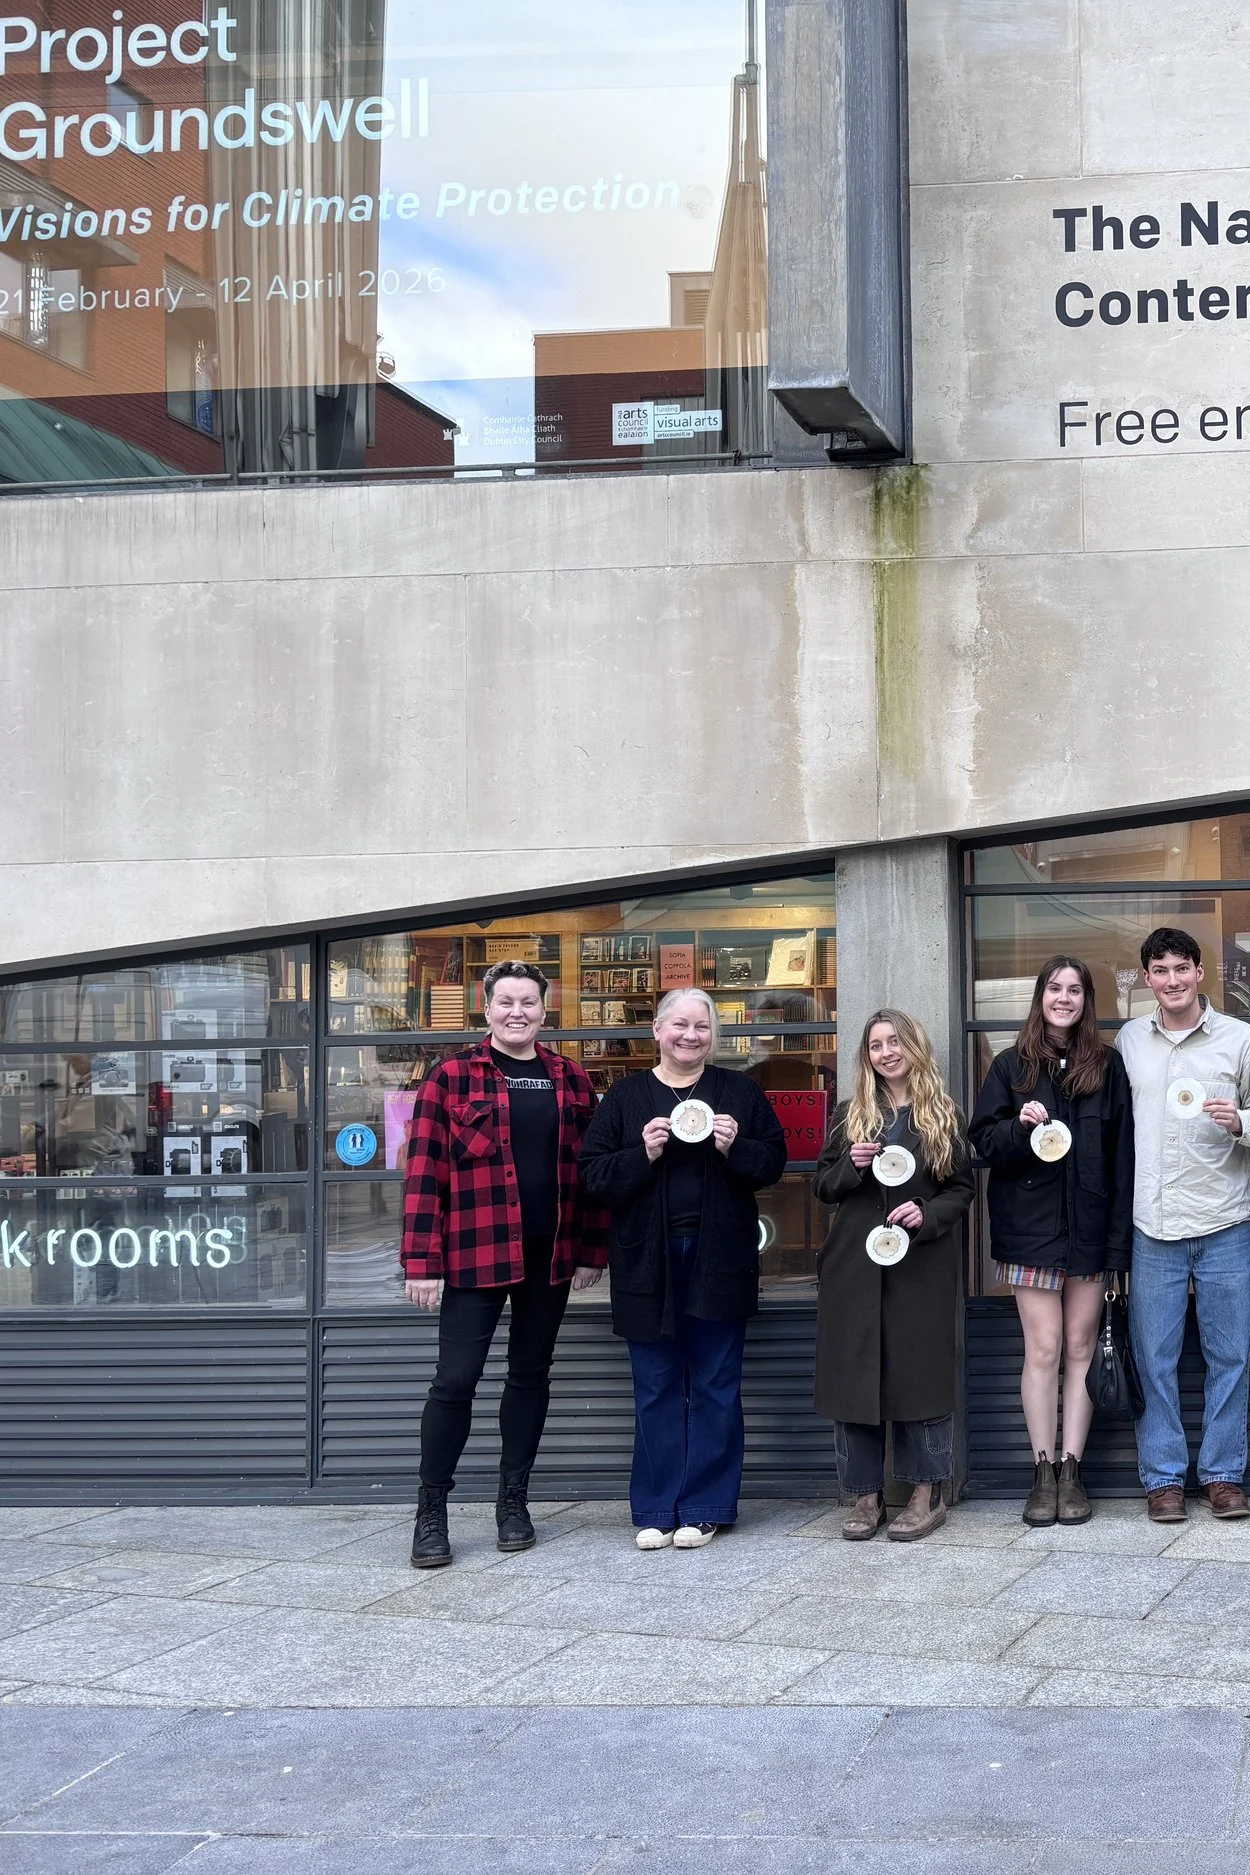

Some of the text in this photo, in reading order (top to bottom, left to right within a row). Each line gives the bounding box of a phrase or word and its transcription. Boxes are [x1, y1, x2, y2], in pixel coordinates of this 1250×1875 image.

[0, 7, 237, 85] Project
[0, 78, 430, 161] Groundswell
[0, 173, 681, 242] Visions for Climate Protection
[1053, 205, 1161, 253] The
[0, 288, 23, 315] 21
[39, 284, 184, 313] February
[219, 277, 251, 304] 12
[265, 271, 343, 305] April
[358, 267, 446, 297] 2026
[623, 407, 648, 419] arts
[657, 415, 719, 428] visual arts
[1058, 401, 1180, 447] Free
[784, 1127, 822, 1139] OYS!
